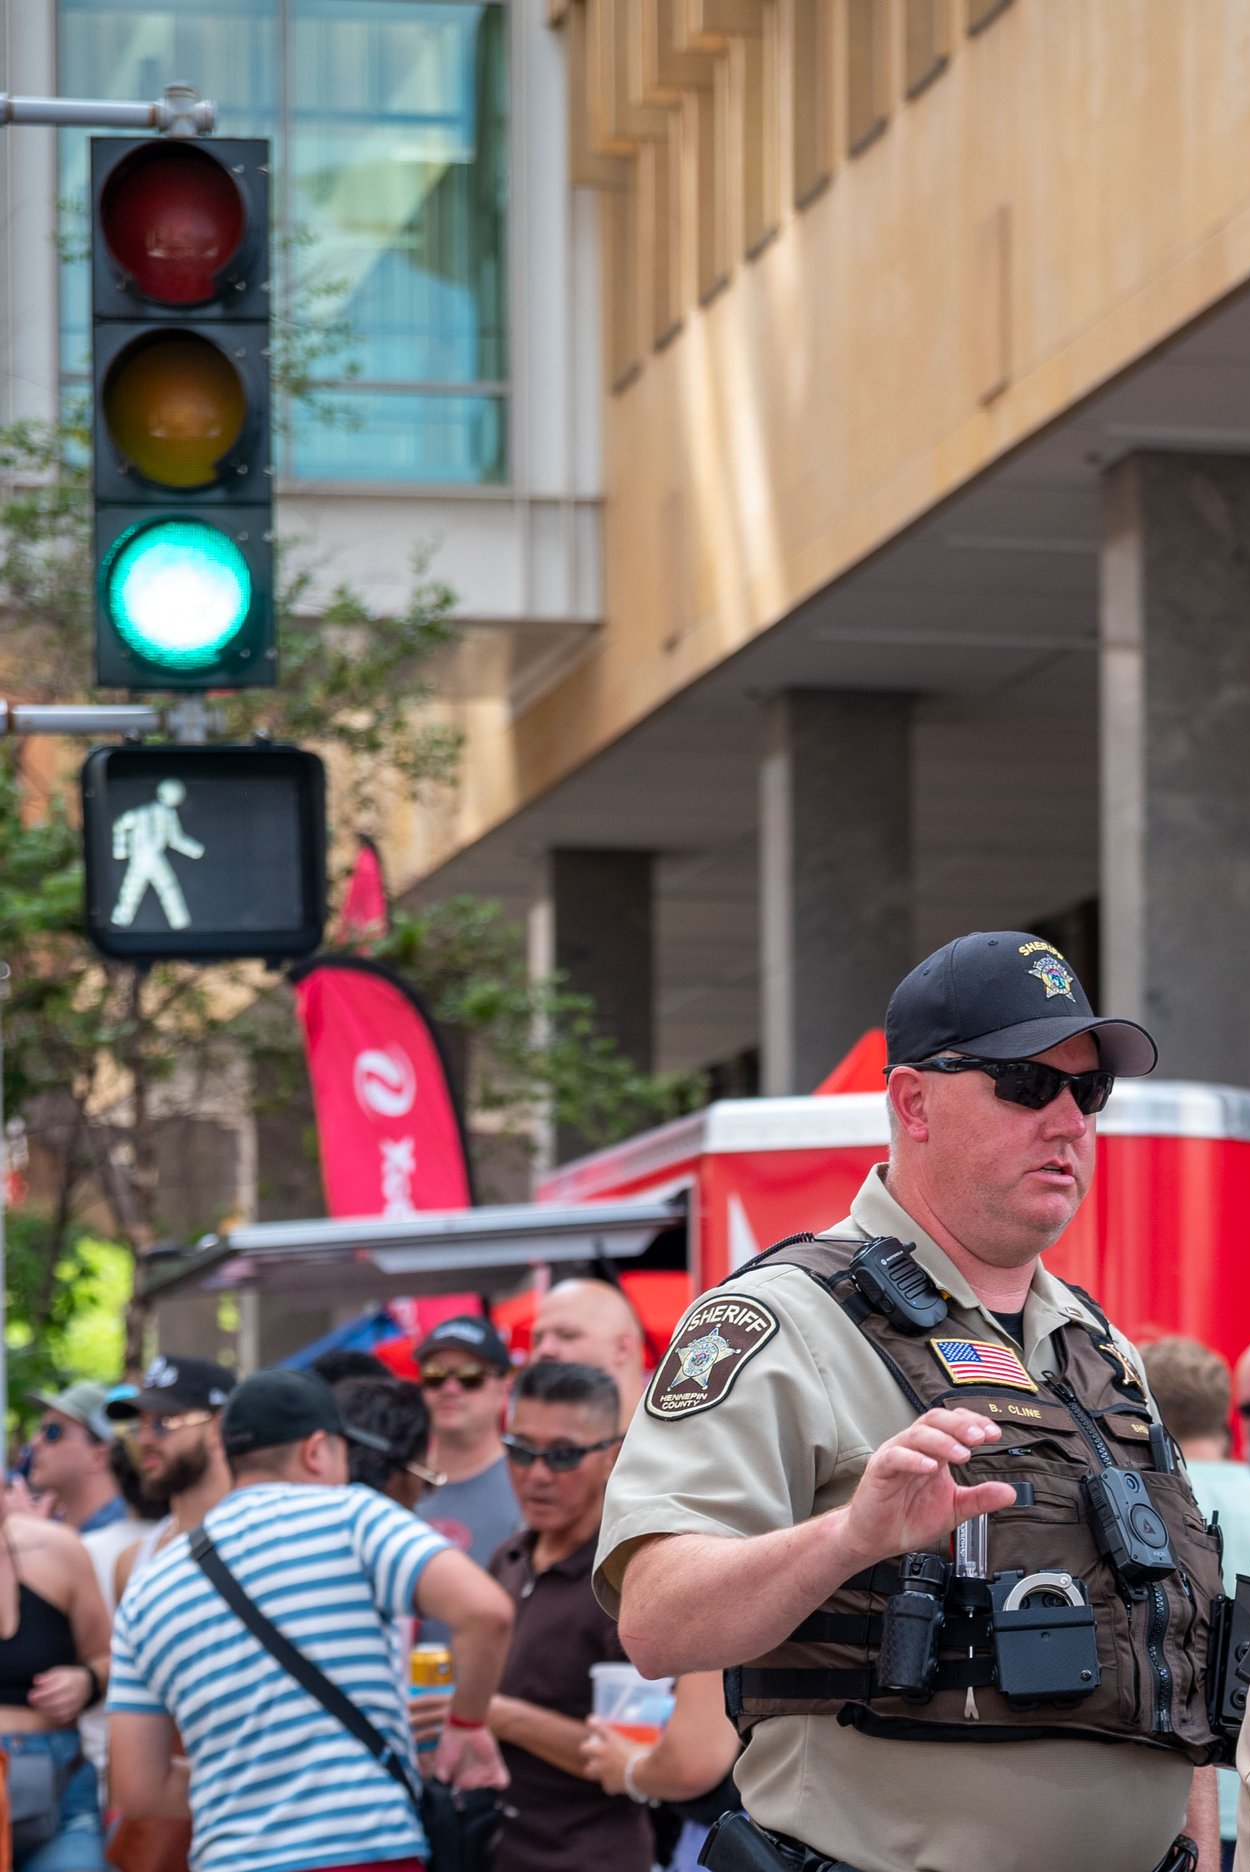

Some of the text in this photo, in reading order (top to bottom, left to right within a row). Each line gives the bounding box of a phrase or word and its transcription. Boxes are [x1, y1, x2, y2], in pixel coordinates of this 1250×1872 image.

[687, 1304, 768, 1333] SHERIFF
[660, 1392, 709, 1403] HENNEPIN
[661, 1400, 700, 1411] COUNTY
[988, 1403, 1042, 1419] B. CLINE
